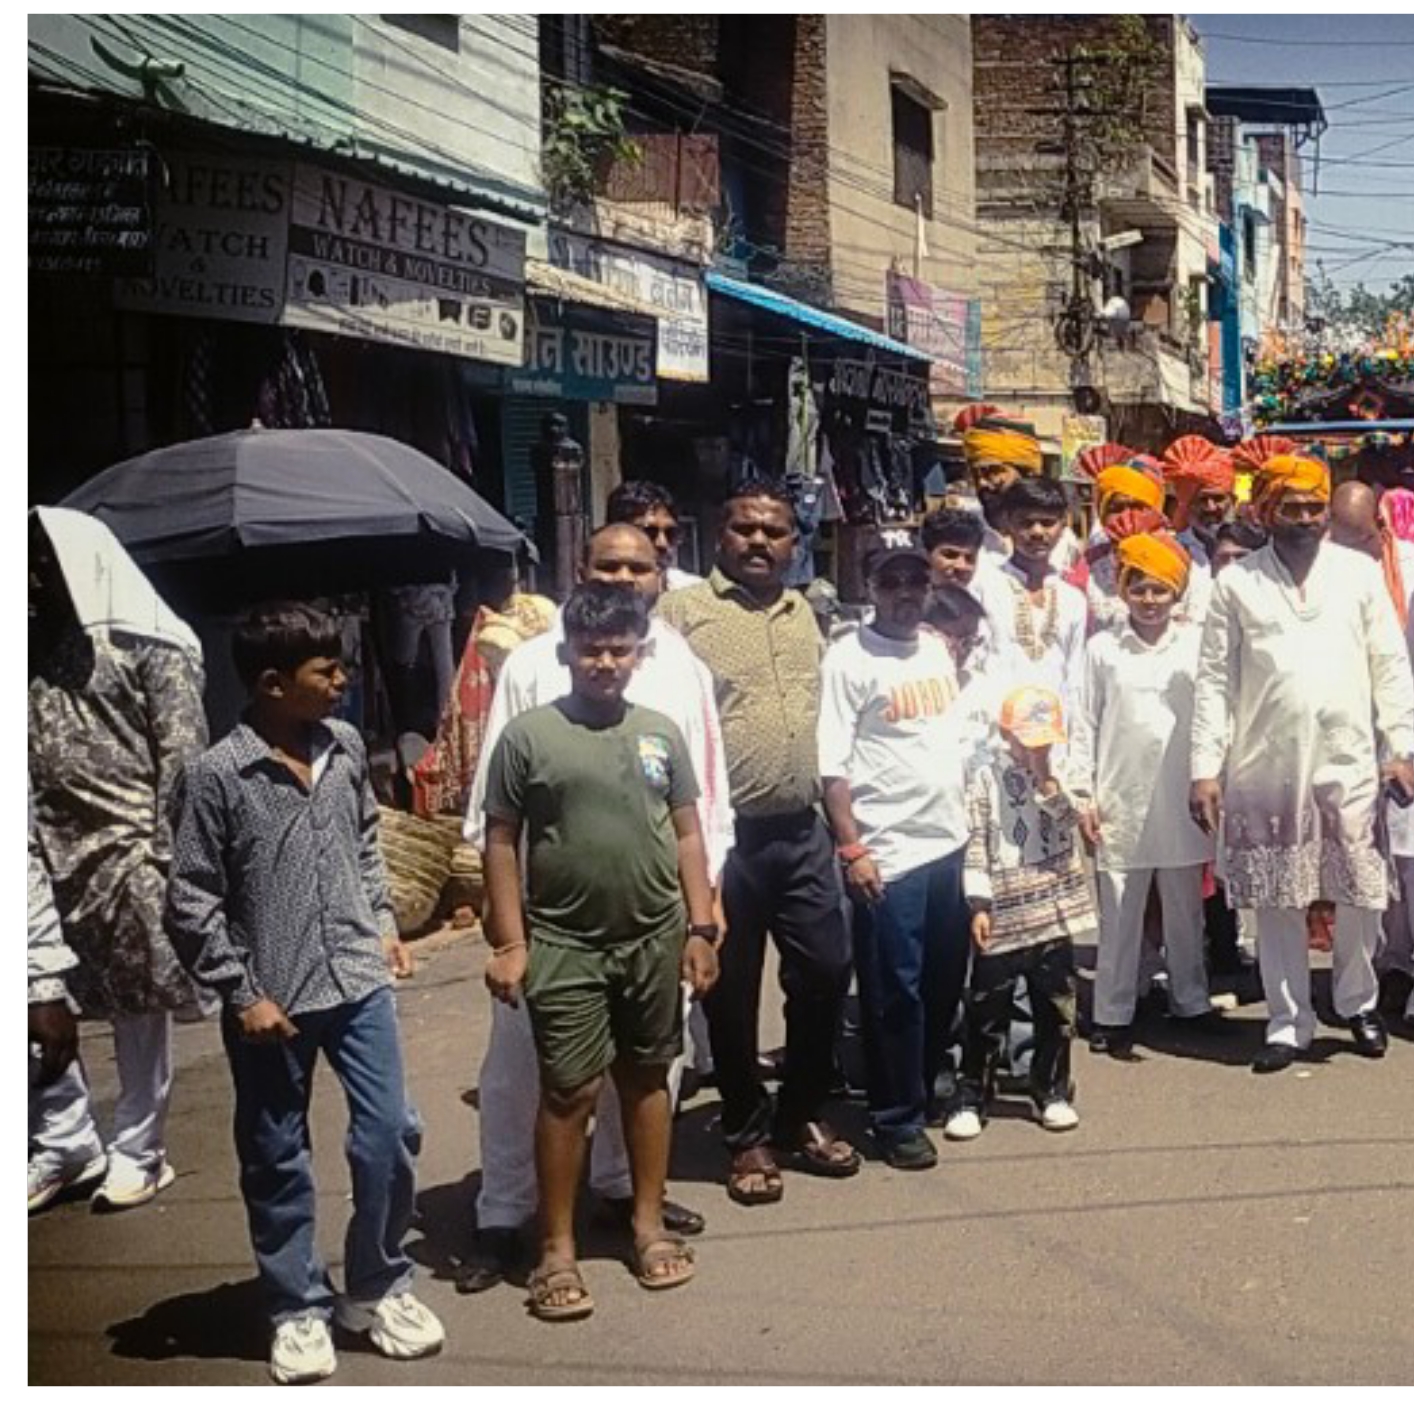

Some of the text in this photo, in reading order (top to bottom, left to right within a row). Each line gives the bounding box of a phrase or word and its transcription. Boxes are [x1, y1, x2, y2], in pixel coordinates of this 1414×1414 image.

[160, 163, 284, 215] AFEES
[160, 223, 269, 259] ATCH
[317, 175, 490, 268] NAFEES
[313, 236, 492, 300] WATCH & NOVELTIES
